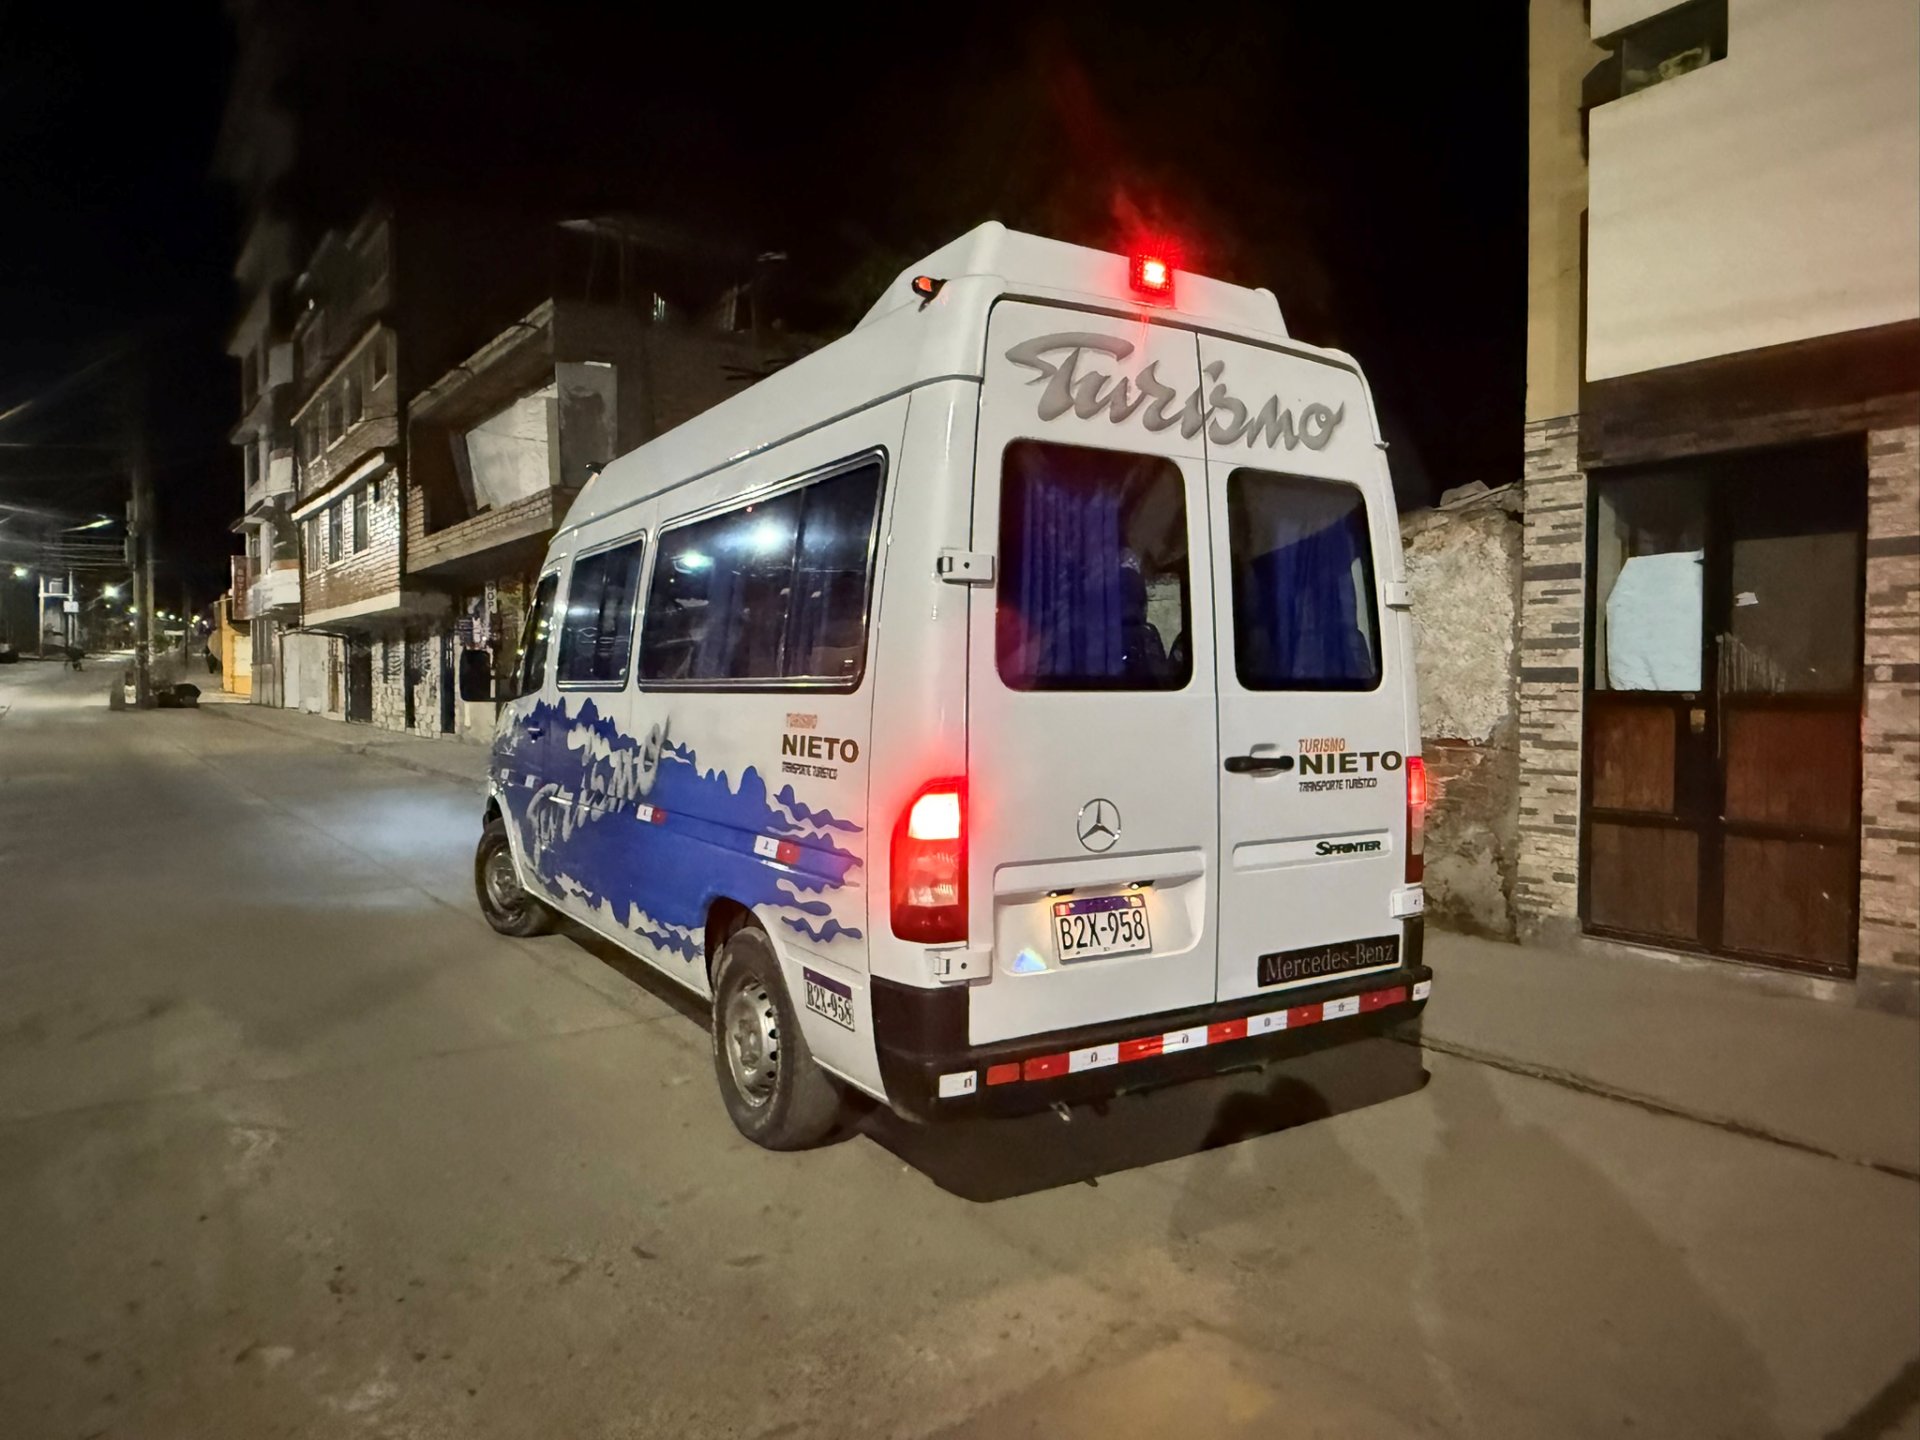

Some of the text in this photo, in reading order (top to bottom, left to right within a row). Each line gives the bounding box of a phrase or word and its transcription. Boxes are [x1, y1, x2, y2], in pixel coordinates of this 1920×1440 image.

[1005, 331, 1345, 451] Turismo
[782, 734, 859, 763] NIETO
[1298, 738, 1346, 754] TURISMO
[1299, 751, 1403, 775] NIETO
[1060, 909, 1145, 950] B2X-958
[1265, 943, 1394, 982] Mercedes-Benz
[806, 981, 852, 1025] B2X-958
